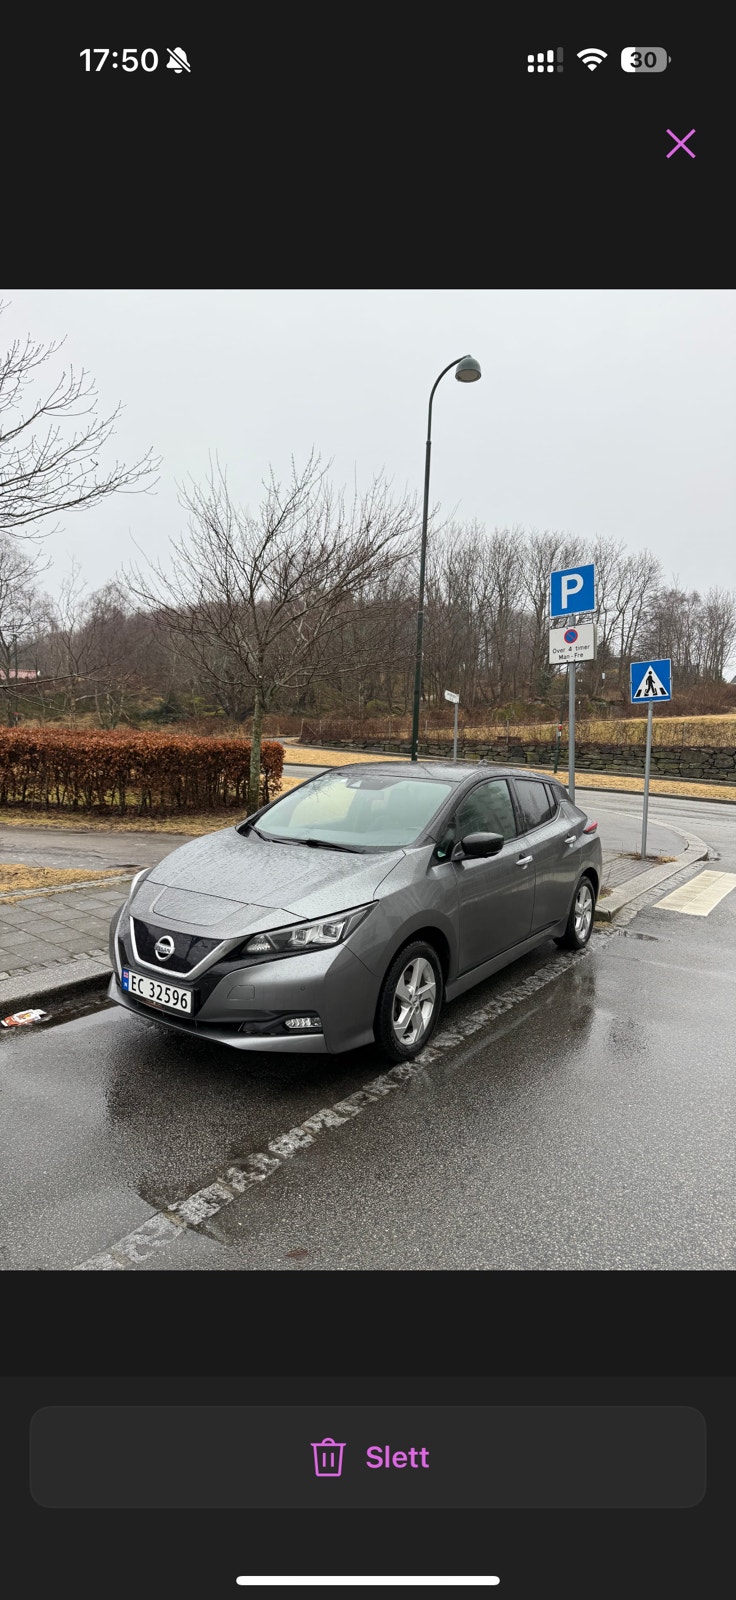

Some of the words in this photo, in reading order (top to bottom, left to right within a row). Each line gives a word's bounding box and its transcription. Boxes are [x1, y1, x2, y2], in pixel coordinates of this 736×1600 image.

[561, 573, 584, 610] P
[132, 975, 144, 994] EC
[149, 982, 188, 1009] 32596
